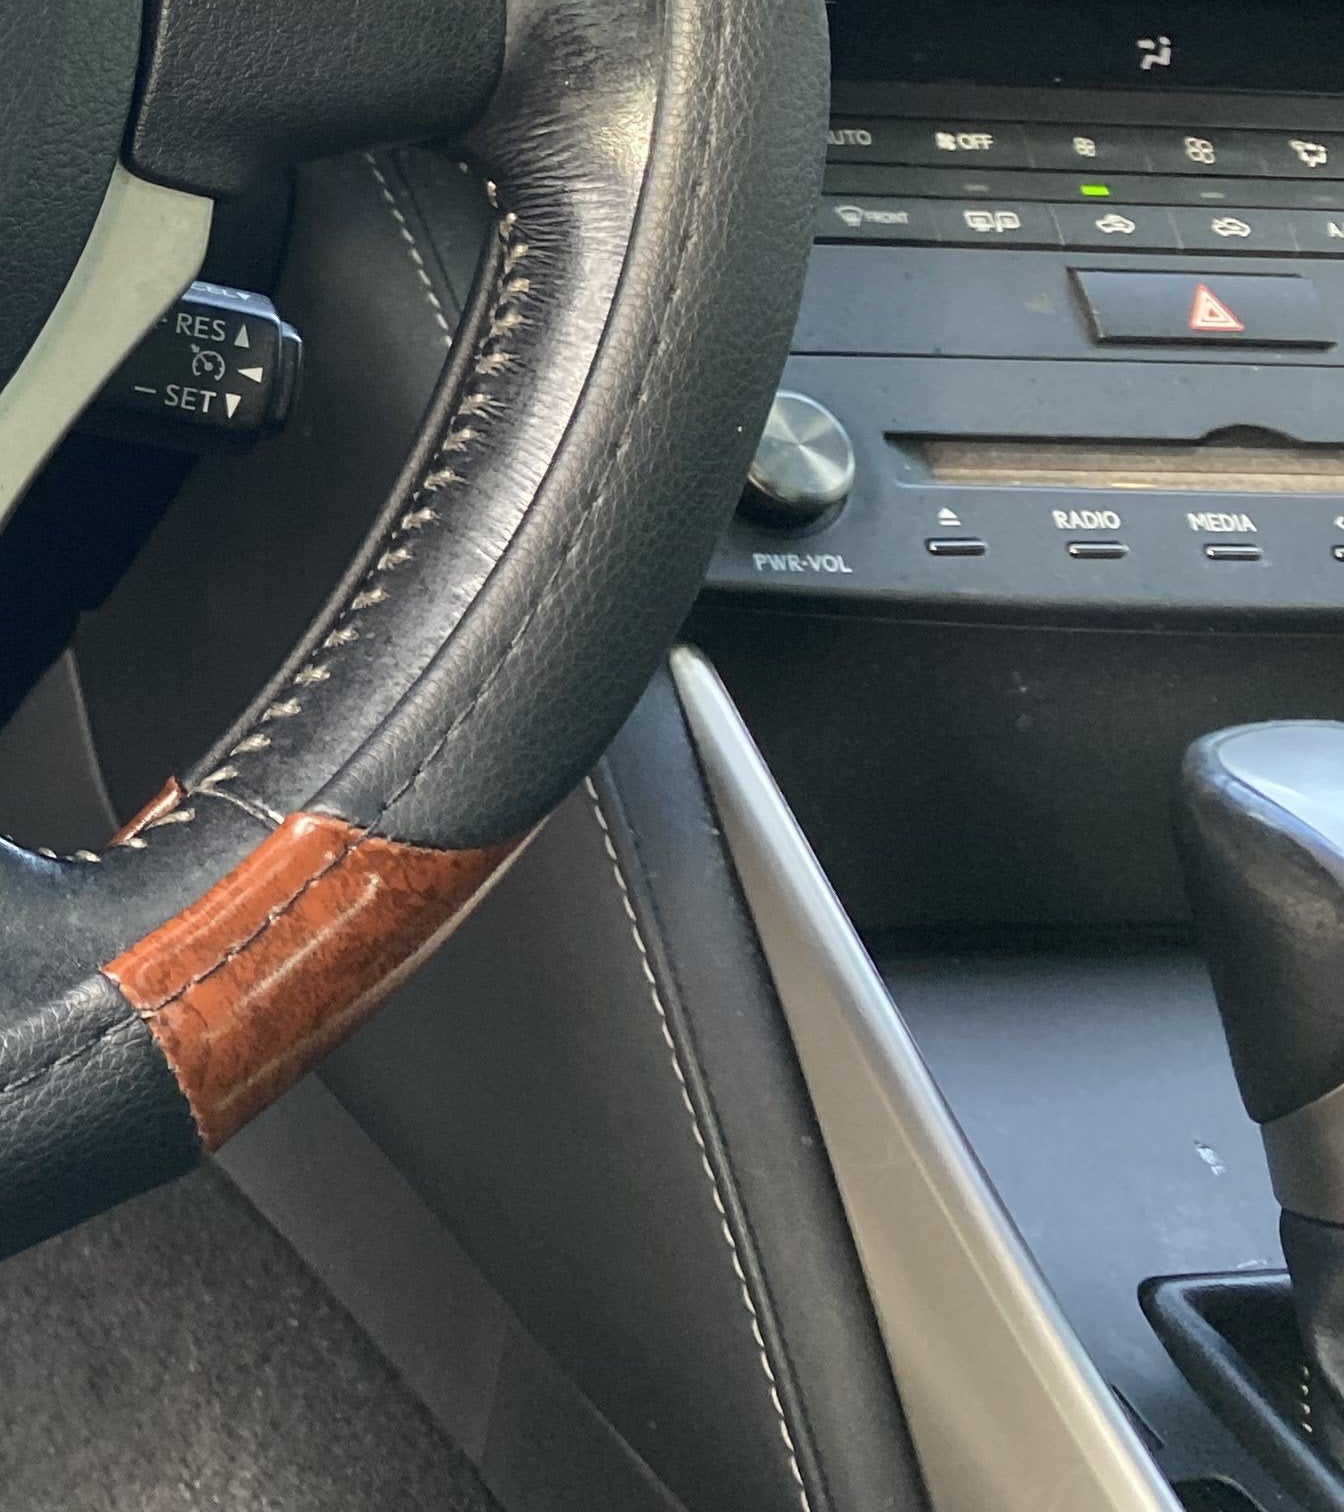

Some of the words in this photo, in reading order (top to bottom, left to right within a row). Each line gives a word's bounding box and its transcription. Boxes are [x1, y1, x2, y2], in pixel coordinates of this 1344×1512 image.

[827, 129, 872, 146] UTO
[957, 132, 994, 150] OFF
[175, 312, 226, 342] RES
[164, 384, 217, 413] SET
[1053, 510, 1121, 531] RADIO
[1187, 512, 1257, 534] MEDIA
[753, 553, 853, 575] PWR-VOL
